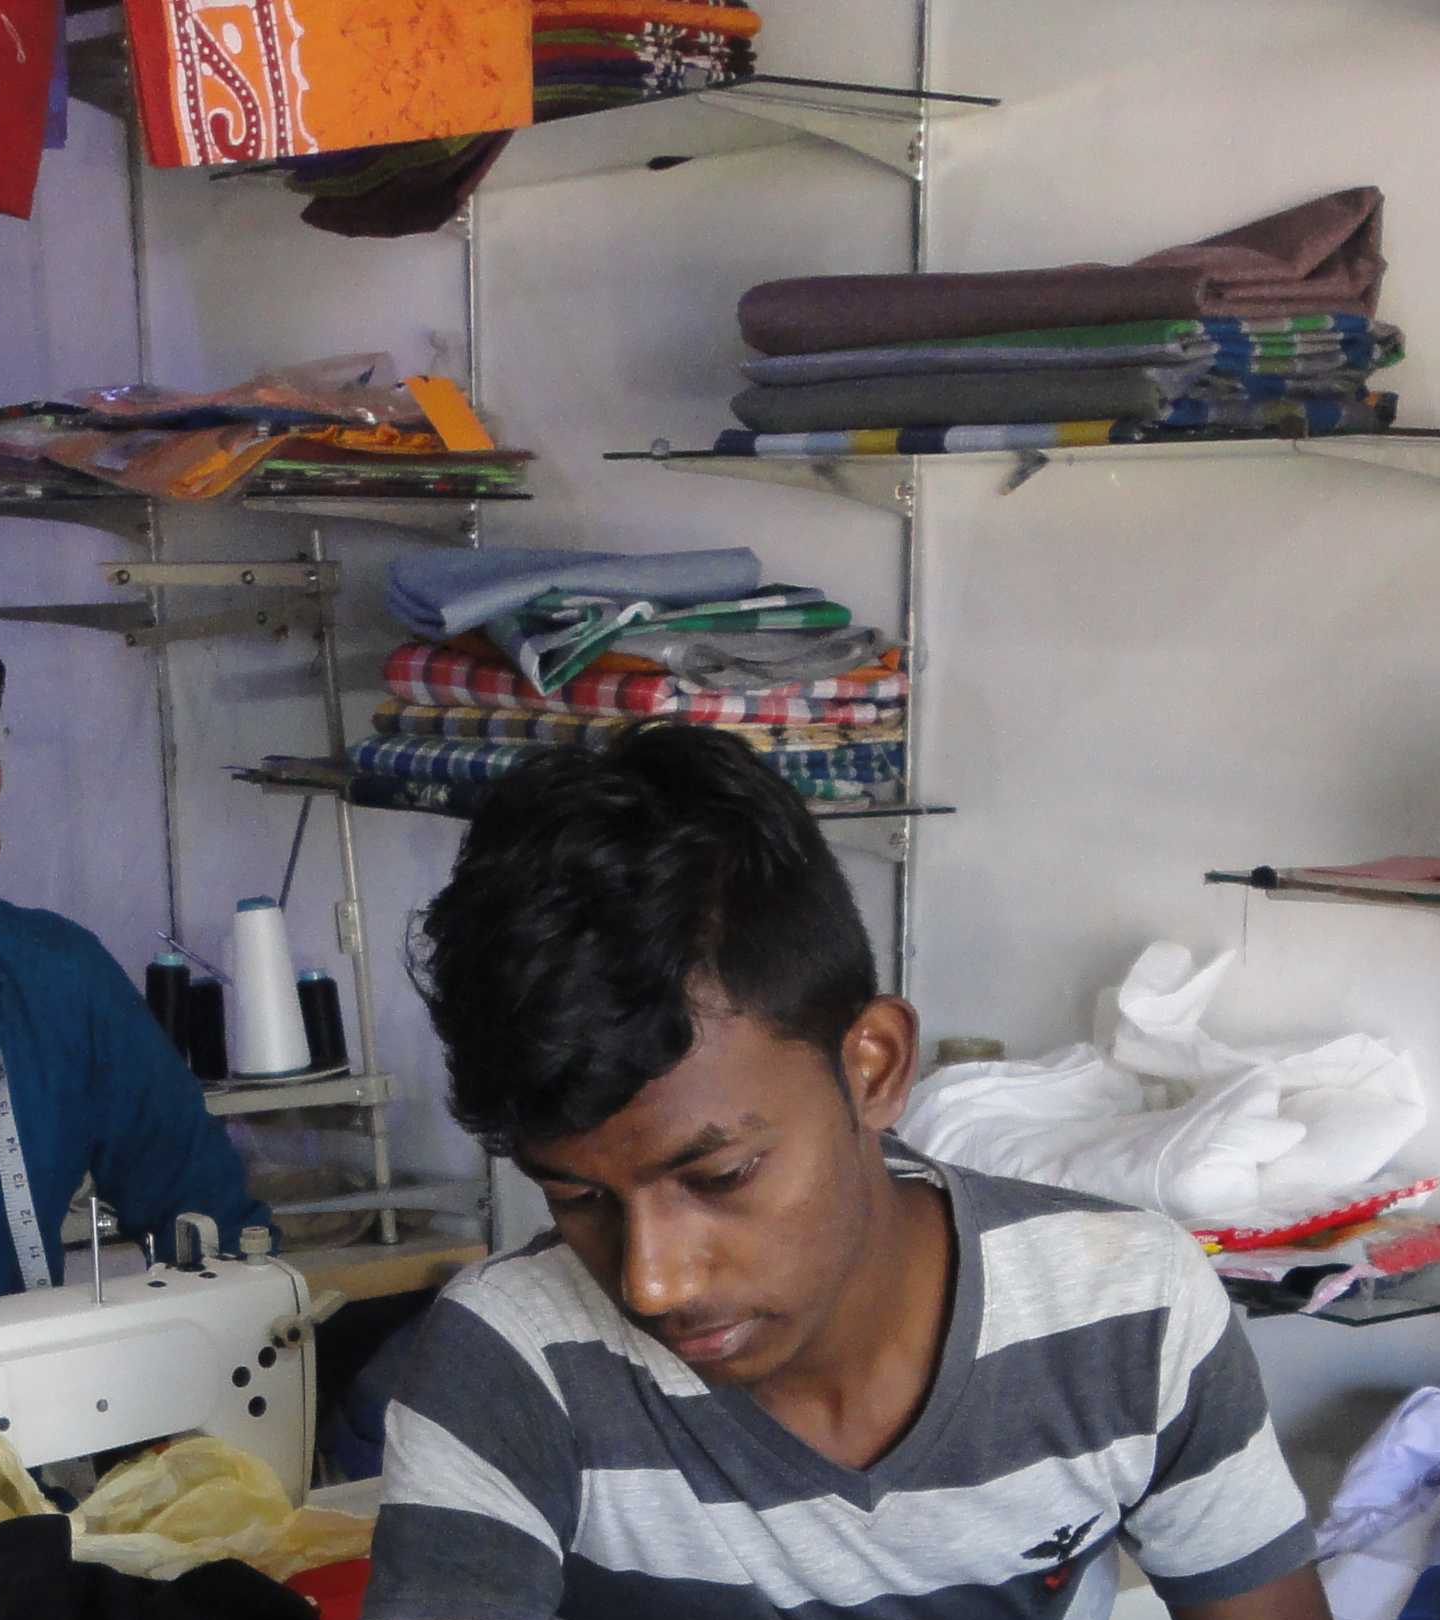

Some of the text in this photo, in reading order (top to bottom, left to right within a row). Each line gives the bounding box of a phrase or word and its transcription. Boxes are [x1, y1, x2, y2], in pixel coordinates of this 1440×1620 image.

[6, 1136, 18, 1153] 14
[13, 1172, 25, 1189] 13
[20, 1209, 33, 1225] 12
